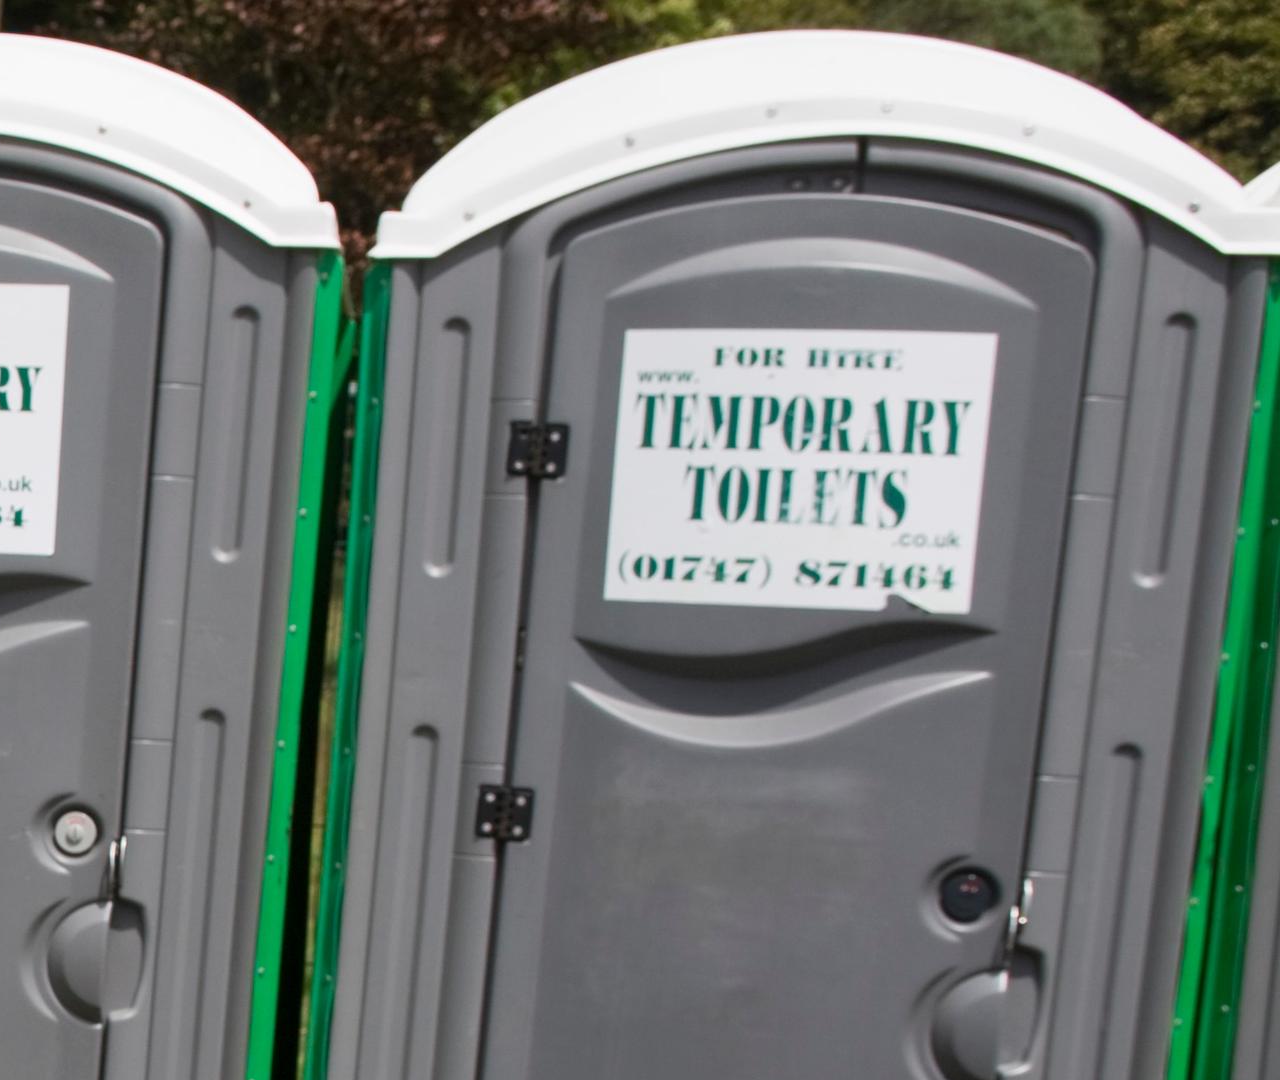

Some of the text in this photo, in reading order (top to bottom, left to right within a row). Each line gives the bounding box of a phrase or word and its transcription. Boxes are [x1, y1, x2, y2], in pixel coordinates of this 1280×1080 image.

[714, 347, 904, 371] FOR HIRE
[638, 371, 698, 382] www.
[636, 391, 972, 455] TEMPORARY
[685, 464, 908, 529] TOILETS
[892, 531, 960, 547] .co.uk
[618, 550, 956, 591] (01747) 871464
